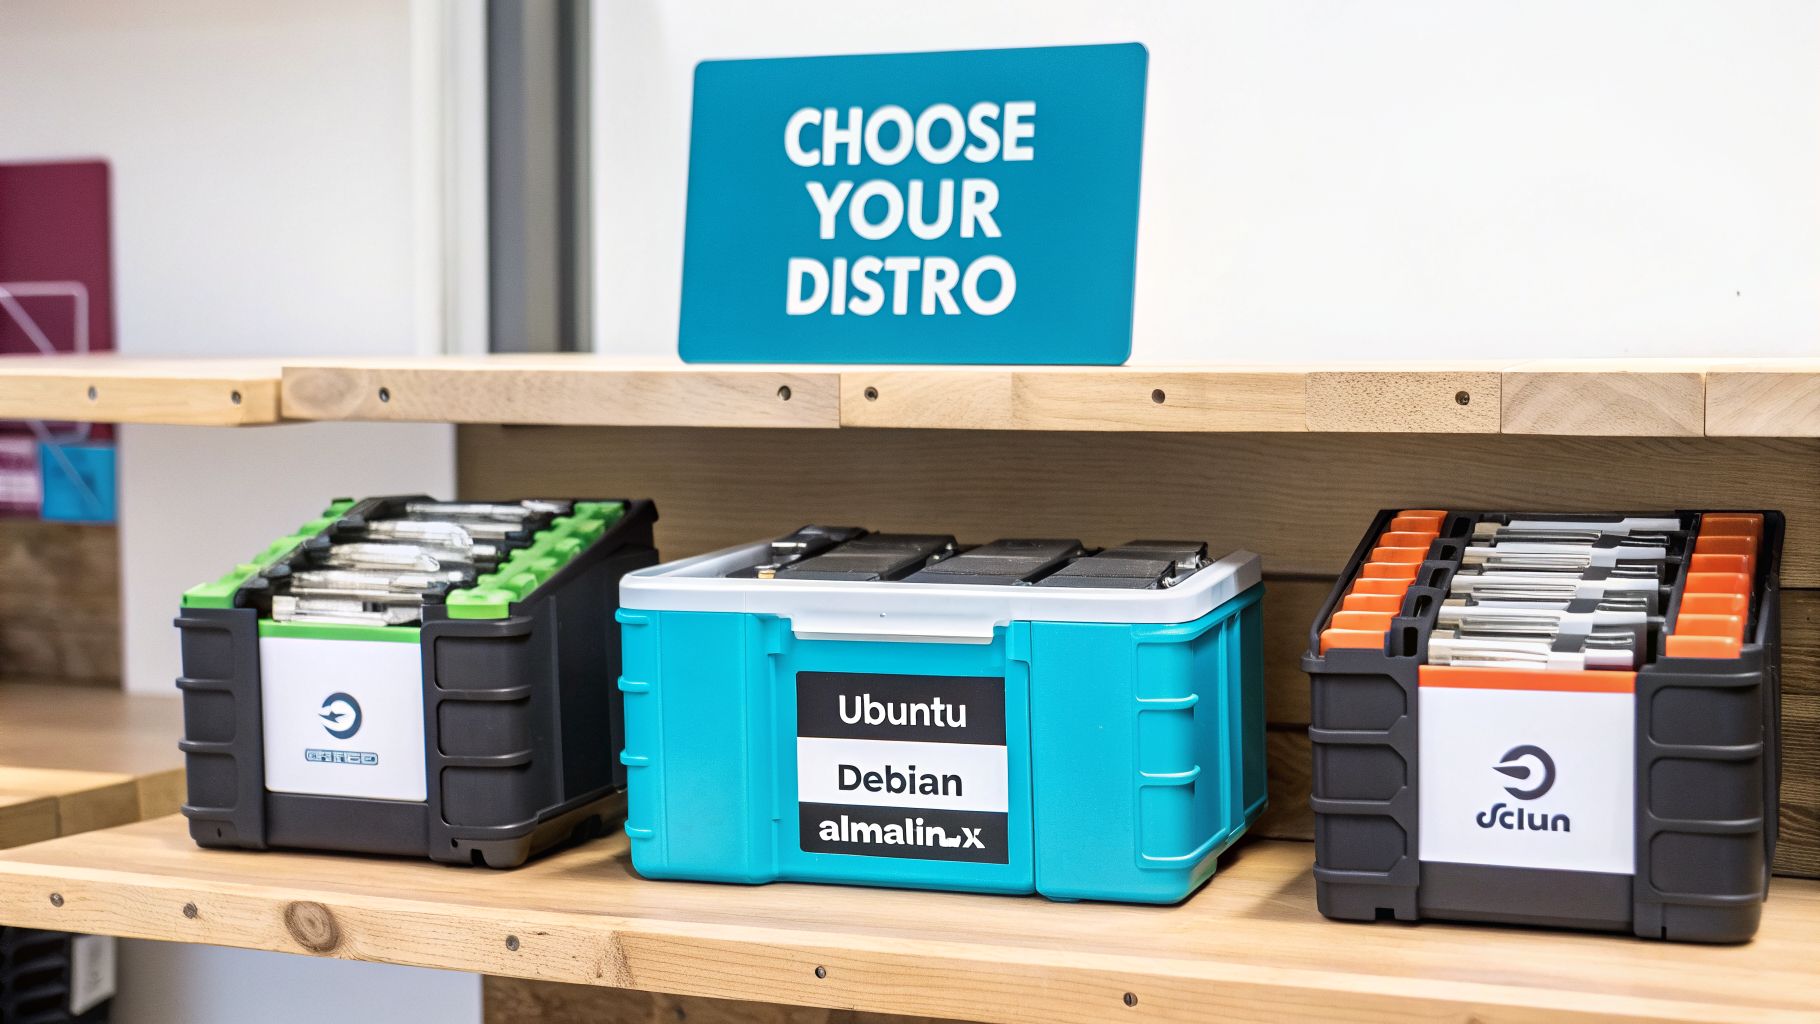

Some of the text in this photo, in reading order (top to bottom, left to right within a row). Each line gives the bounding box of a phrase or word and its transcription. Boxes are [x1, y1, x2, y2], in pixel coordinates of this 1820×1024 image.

[784, 101, 1036, 167] CHOOSE
[806, 178, 1002, 241] YOUR
[786, 255, 1017, 316] DISTRO
[838, 693, 967, 728] Ubuntu
[838, 764, 963, 797] Debian
